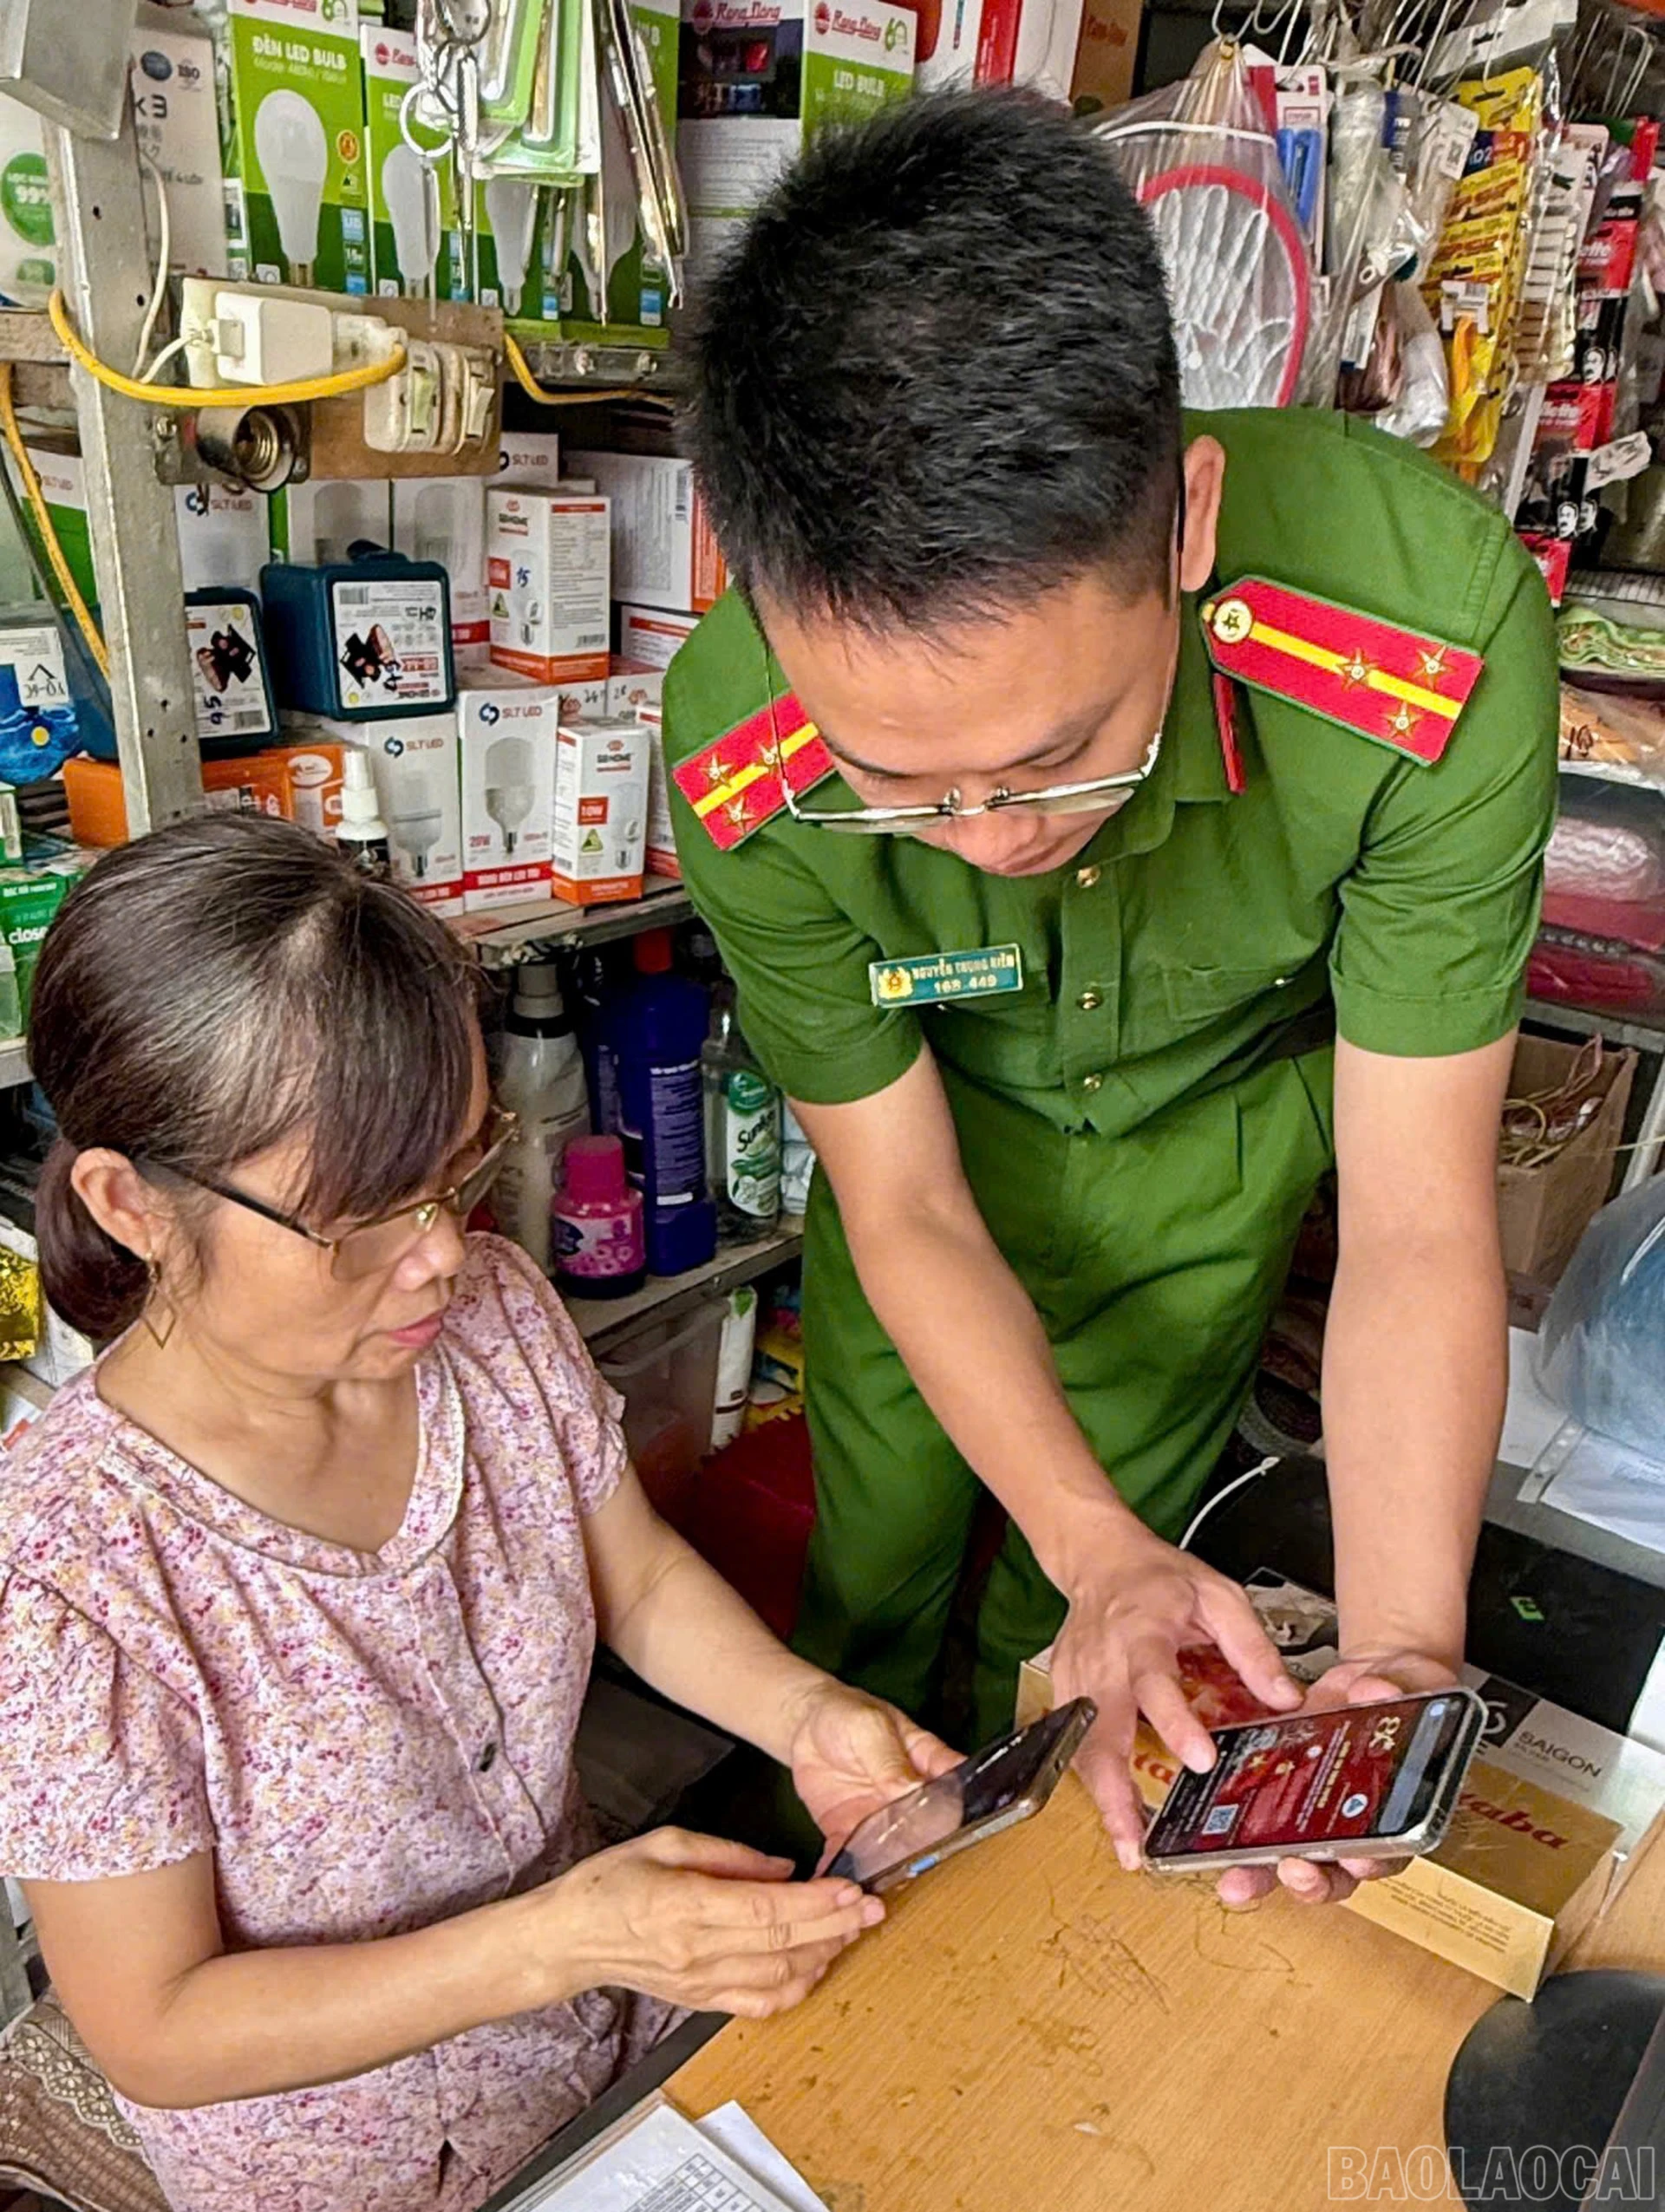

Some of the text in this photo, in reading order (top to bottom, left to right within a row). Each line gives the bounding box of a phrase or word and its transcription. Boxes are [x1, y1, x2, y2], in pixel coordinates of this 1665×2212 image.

[284, 42, 310, 65] LED
[313, 48, 348, 71] BULB
[1518, 1731, 1603, 1778] SAIGON
